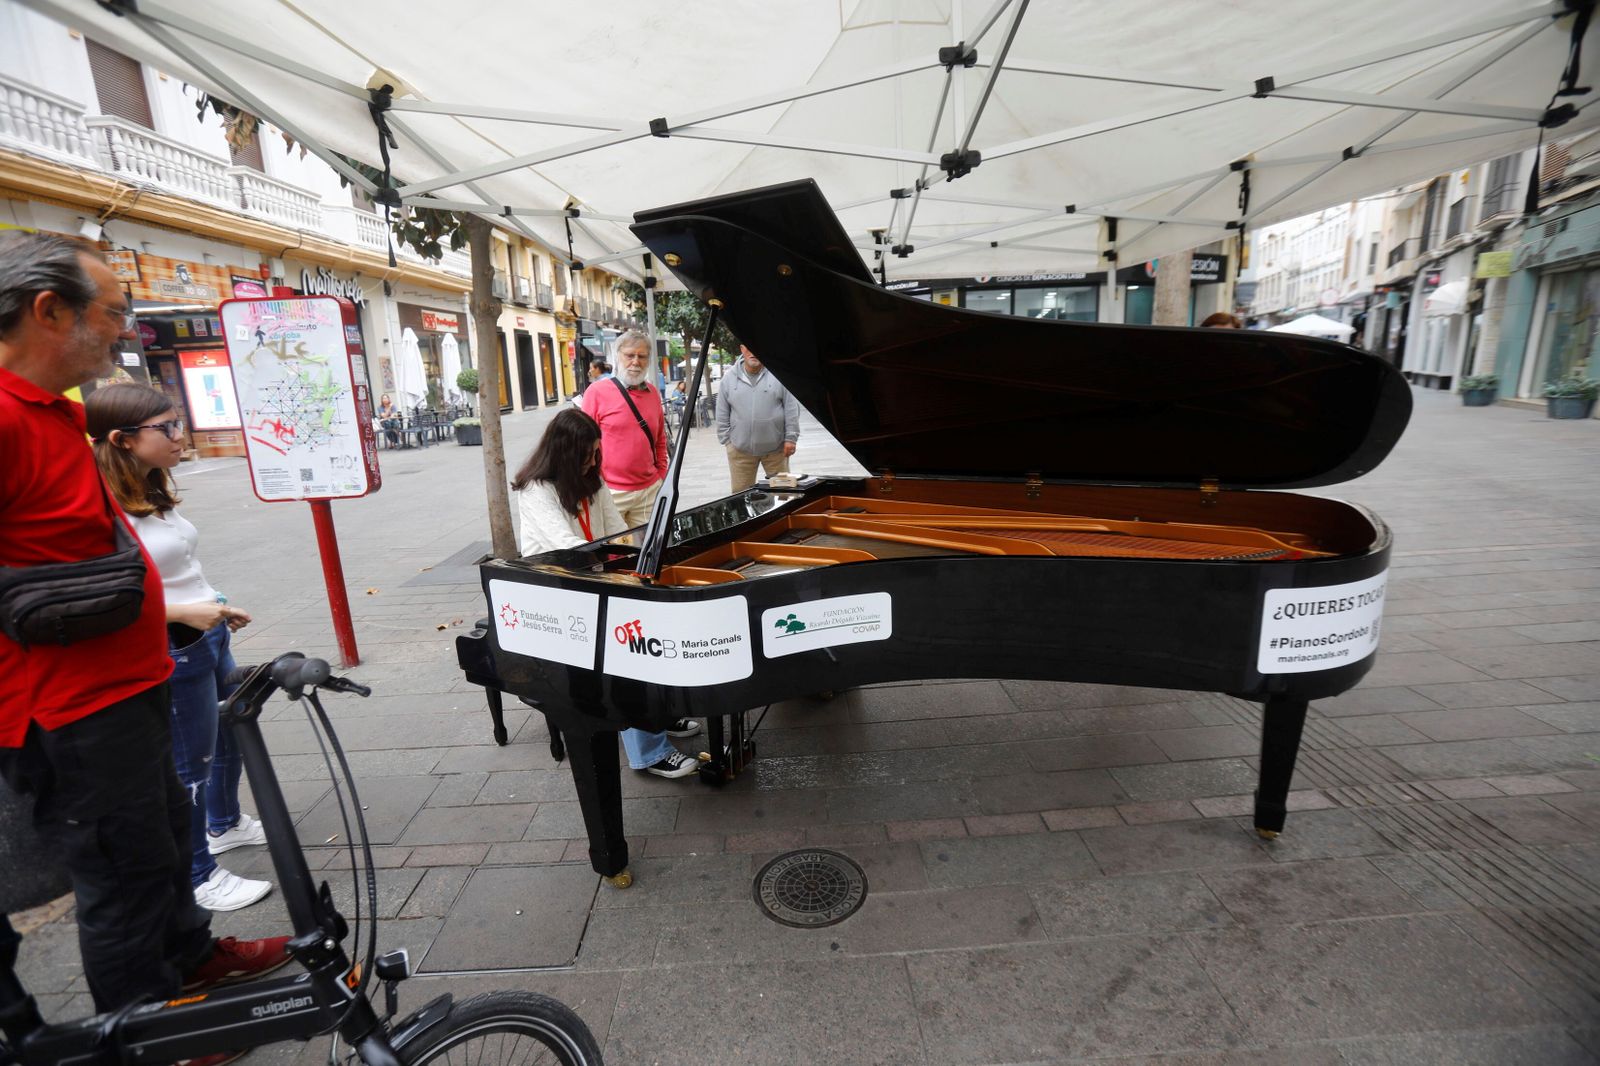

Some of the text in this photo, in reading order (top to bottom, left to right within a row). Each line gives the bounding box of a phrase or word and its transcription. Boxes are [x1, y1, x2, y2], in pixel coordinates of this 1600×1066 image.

[163, 284, 184, 293] COFFEE
[823, 606, 865, 618] FUNDACIÓN
[1273, 596, 1355, 620] ¿QUIERES
[520, 609, 559, 625] Fundación
[568, 615, 587, 634] 25
[522, 620, 563, 635] Jesús Serra
[614, 619, 643, 645] OFF
[852, 624, 881, 634] COVAP
[570, 633, 589, 643] años
[681, 634, 742, 649] Maria Canals
[1270, 626, 1369, 649] #PianosCordoba
[629, 635, 678, 659] MCB
[683, 648, 730, 659] Barcelona
[1277, 648, 1350, 663] mariacanals.org
[762, 853, 826, 911] ABASTECIMIENTO
[252, 995, 314, 1017] quipplan
